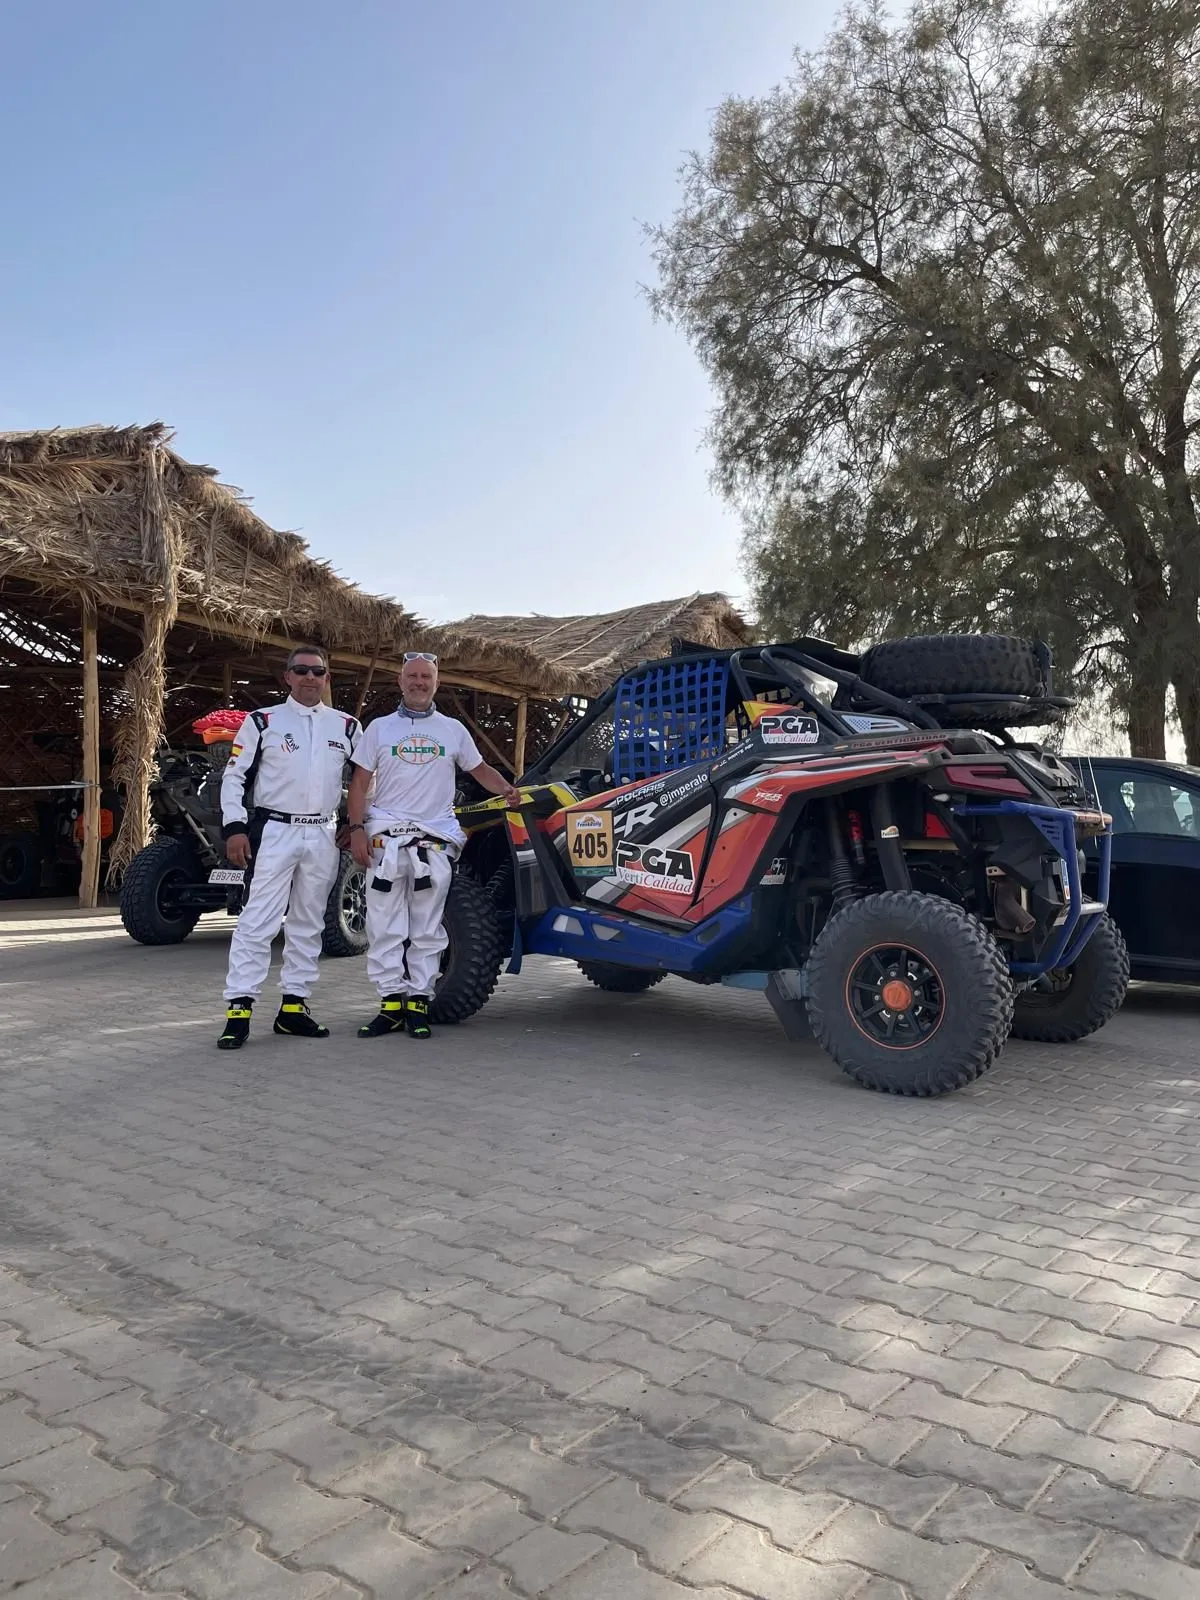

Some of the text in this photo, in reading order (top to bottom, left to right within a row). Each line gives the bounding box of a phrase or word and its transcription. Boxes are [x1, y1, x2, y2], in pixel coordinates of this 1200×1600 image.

[762, 717, 817, 734] PGA
[401, 746, 437, 754] ALCER
[616, 782, 666, 805] POLARIS
[660, 772, 708, 806] @jmperalo
[573, 833, 607, 859] 405
[617, 841, 694, 880] PGA
[617, 868, 694, 893] VertiCalidad
